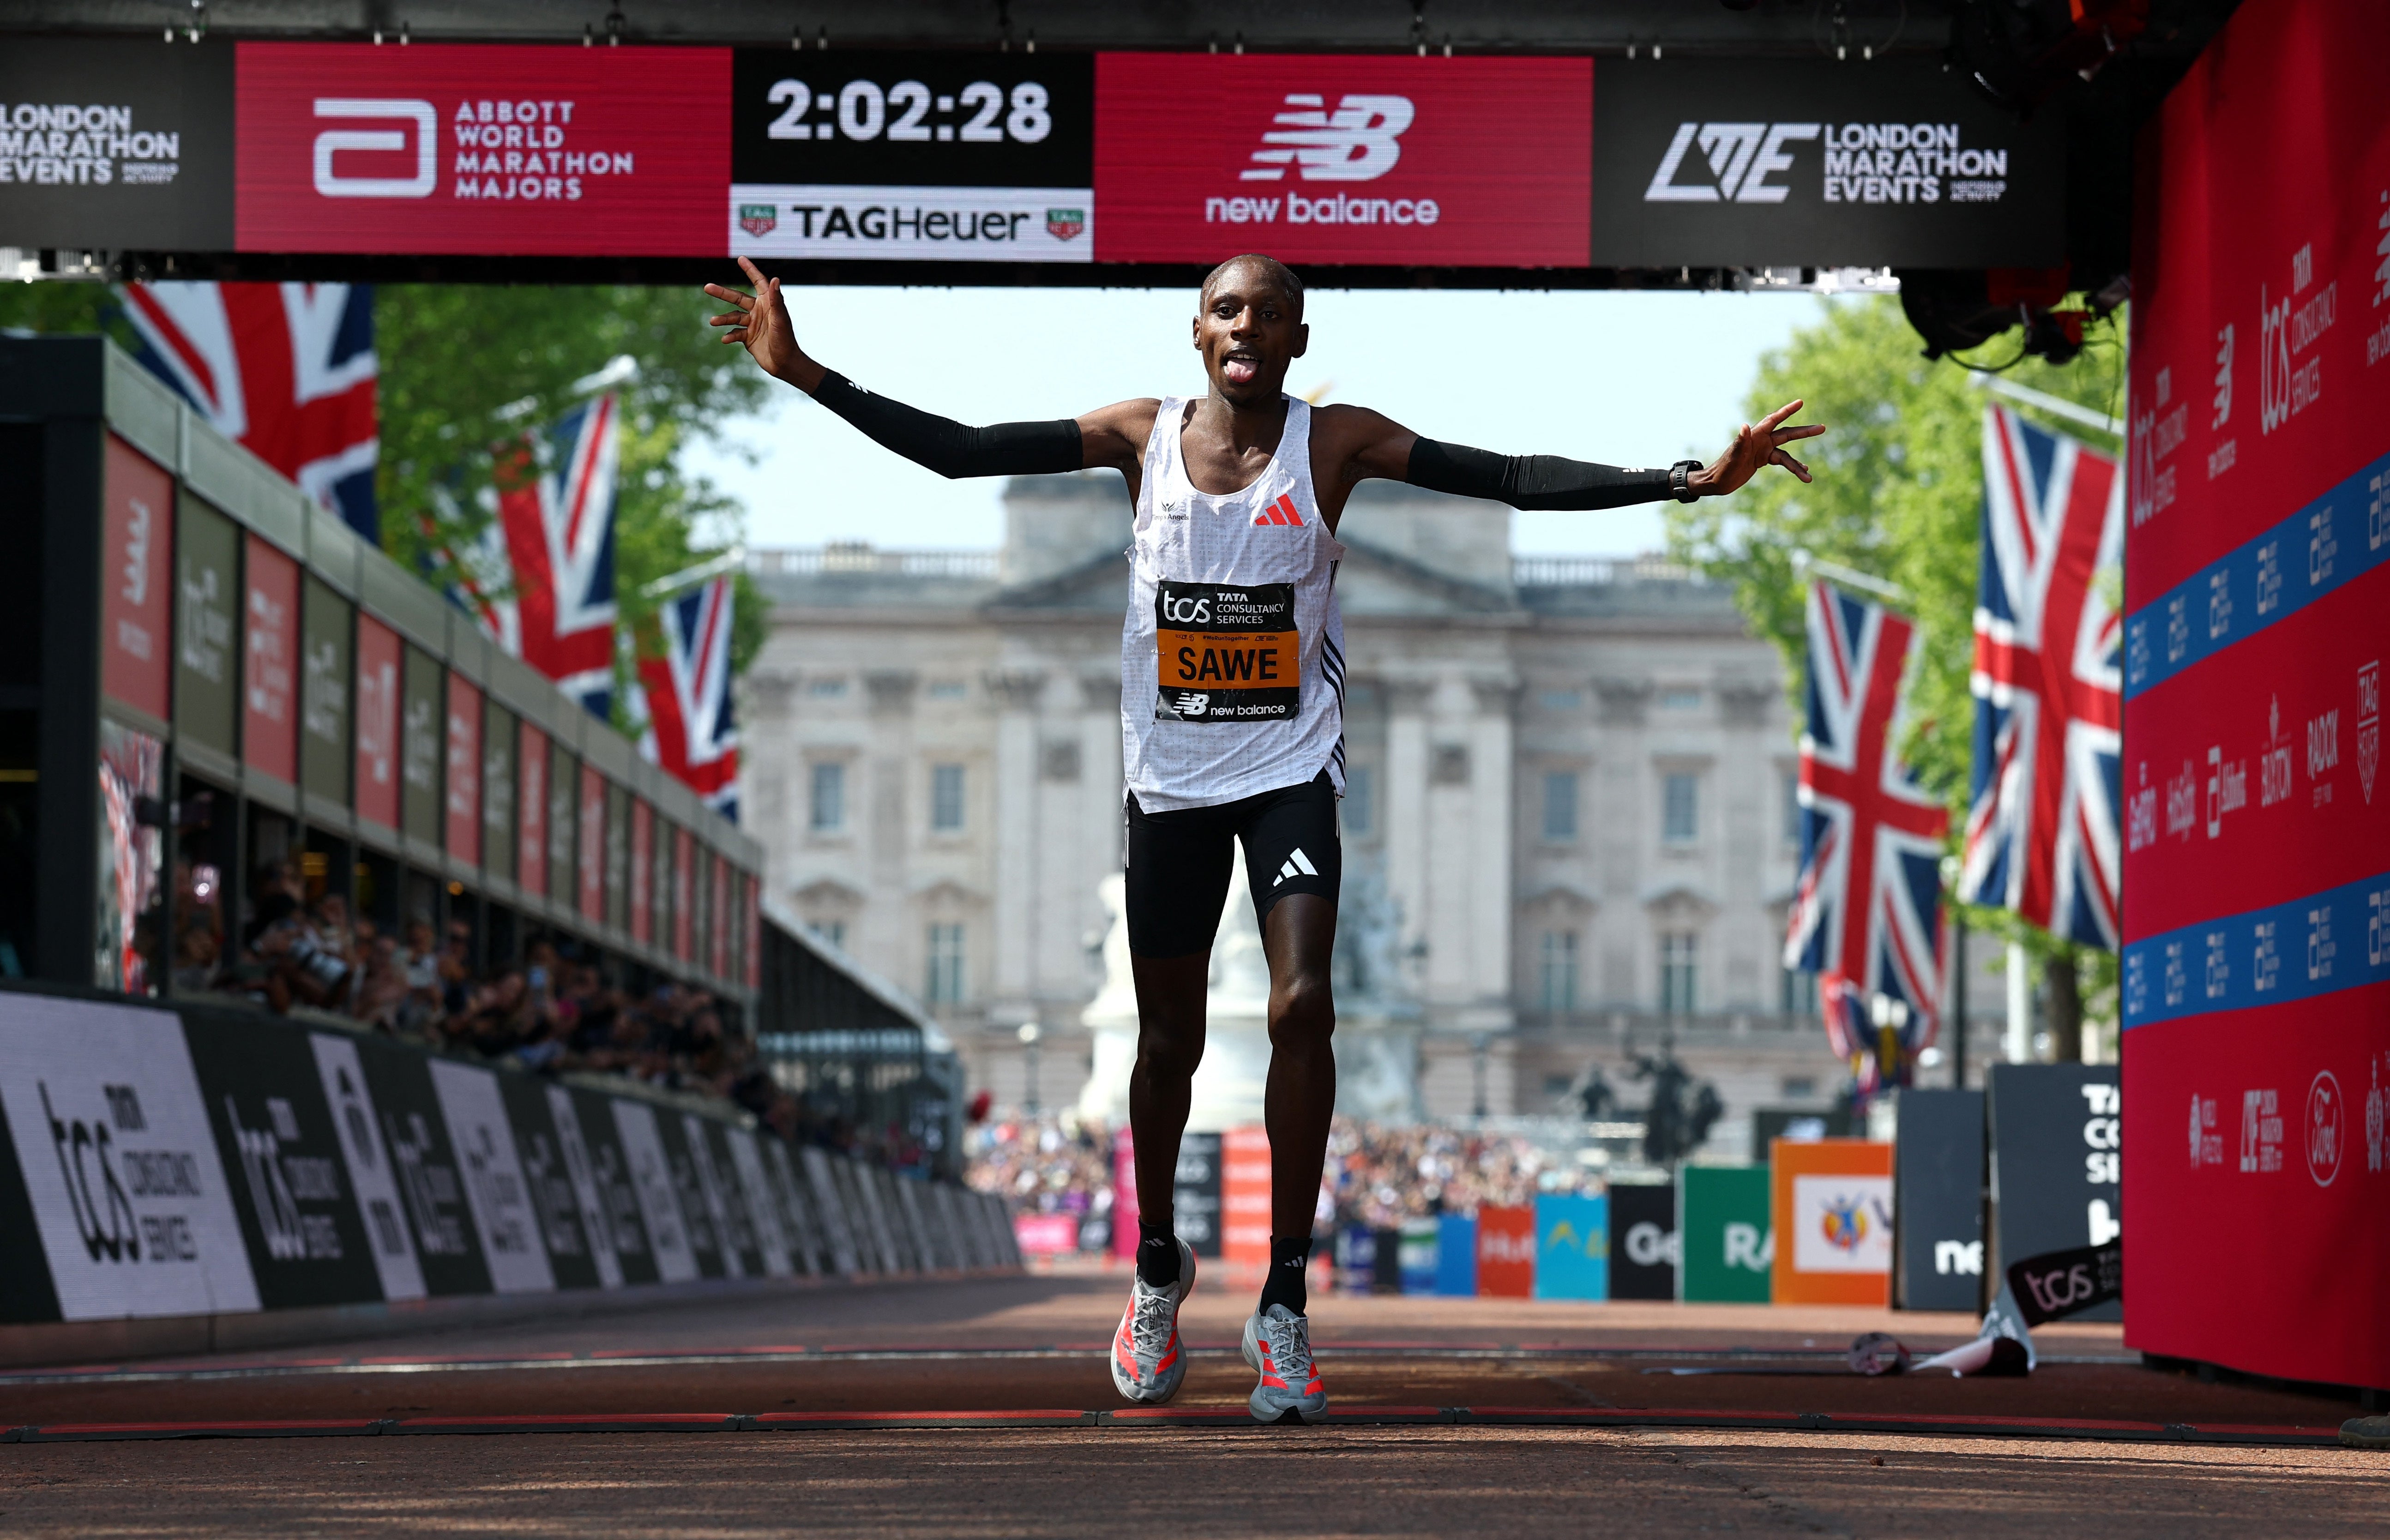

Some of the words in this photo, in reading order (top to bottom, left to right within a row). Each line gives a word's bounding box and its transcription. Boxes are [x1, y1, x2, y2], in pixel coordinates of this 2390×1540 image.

[0, 103, 132, 131] LONDON
[454, 99, 575, 123] ABBOTT
[766, 78, 1053, 144] 2:02:28
[0, 130, 180, 159] MARATHON
[454, 124, 566, 148] WORLD
[1824, 123, 1959, 150] LONDON
[0, 156, 113, 185] EVENTS
[454, 150, 634, 174] MARATHON
[1824, 149, 2008, 176] MARATHON
[454, 176, 583, 200] MAJORS
[1824, 177, 1939, 204] EVENTS
[1205, 196, 1282, 223] new
[1287, 190, 1440, 226] balance
[1163, 590, 1210, 623] tcs
[1216, 603, 1285, 614] CONSULTANCY
[1217, 593, 1248, 602] TATA
[1216, 615, 1264, 624] SERVICES
[1178, 647, 1277, 681] SAWE
[2359, 671, 2377, 716] TAG
[1210, 707, 1234, 716] new
[1237, 704, 1286, 716] balance
[2308, 708, 2338, 781] RADOX
[37, 1079, 141, 1263] tcs
[2024, 1263, 2094, 1312] tcs
